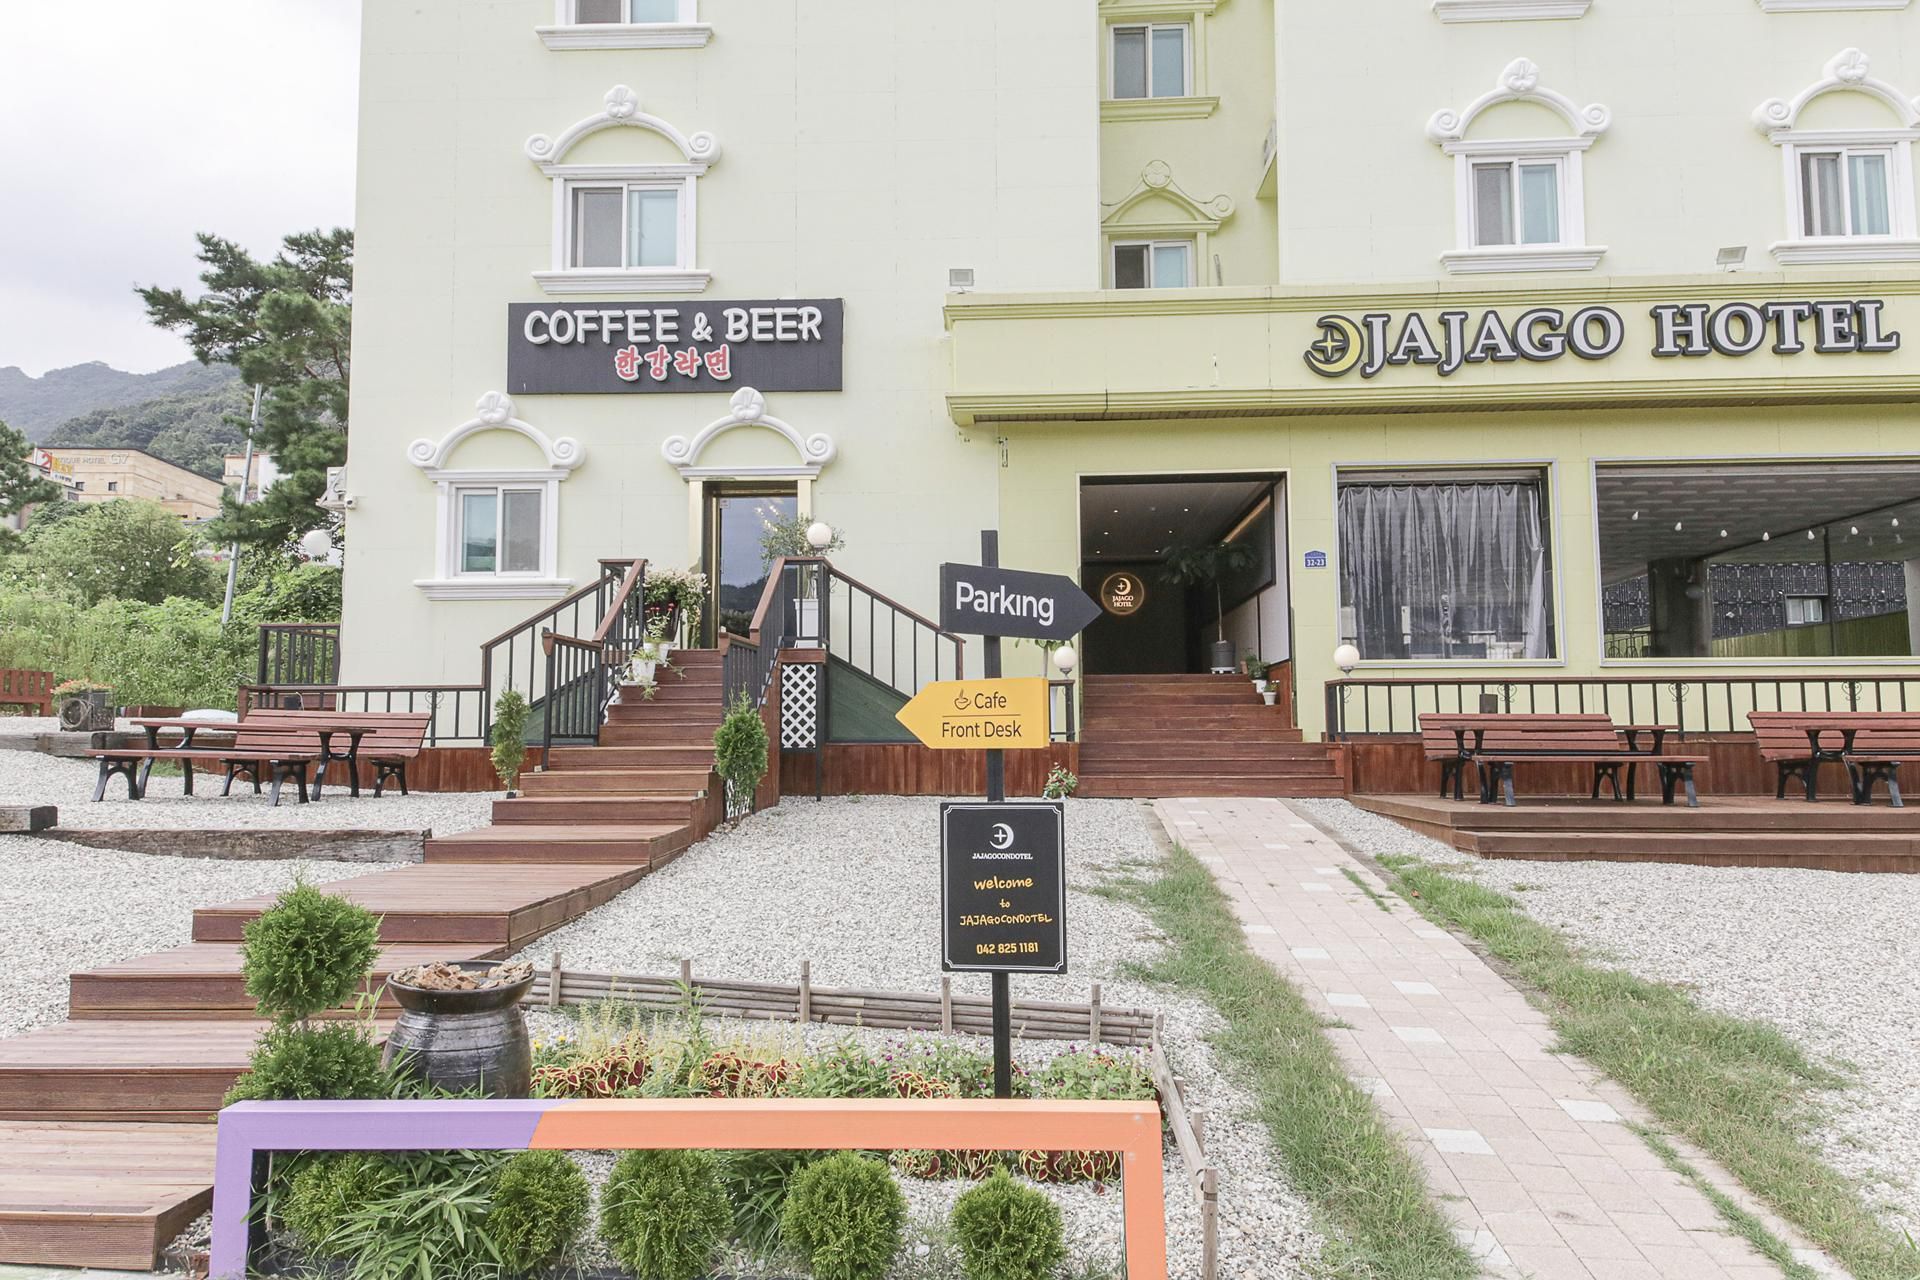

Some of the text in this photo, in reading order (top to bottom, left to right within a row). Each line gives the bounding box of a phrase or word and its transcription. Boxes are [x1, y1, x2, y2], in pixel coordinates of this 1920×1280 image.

[523, 306, 823, 345] COFFEE & BEER
[1361, 300, 1901, 378] JAJAGO HOTEL
[614, 344, 732, 382] 한강라면
[955, 581, 1054, 626] Parking
[973, 691, 1007, 709] Cafe
[942, 720, 1022, 738] Front Desk
[972, 852, 1034, 861] JAJAGOCONDOTEL
[973, 875, 1034, 891] welcome
[999, 898, 1011, 909] to
[959, 913, 1053, 928] JAJAGOCONDOTEL
[976, 942, 1039, 955] 042 825 1181
